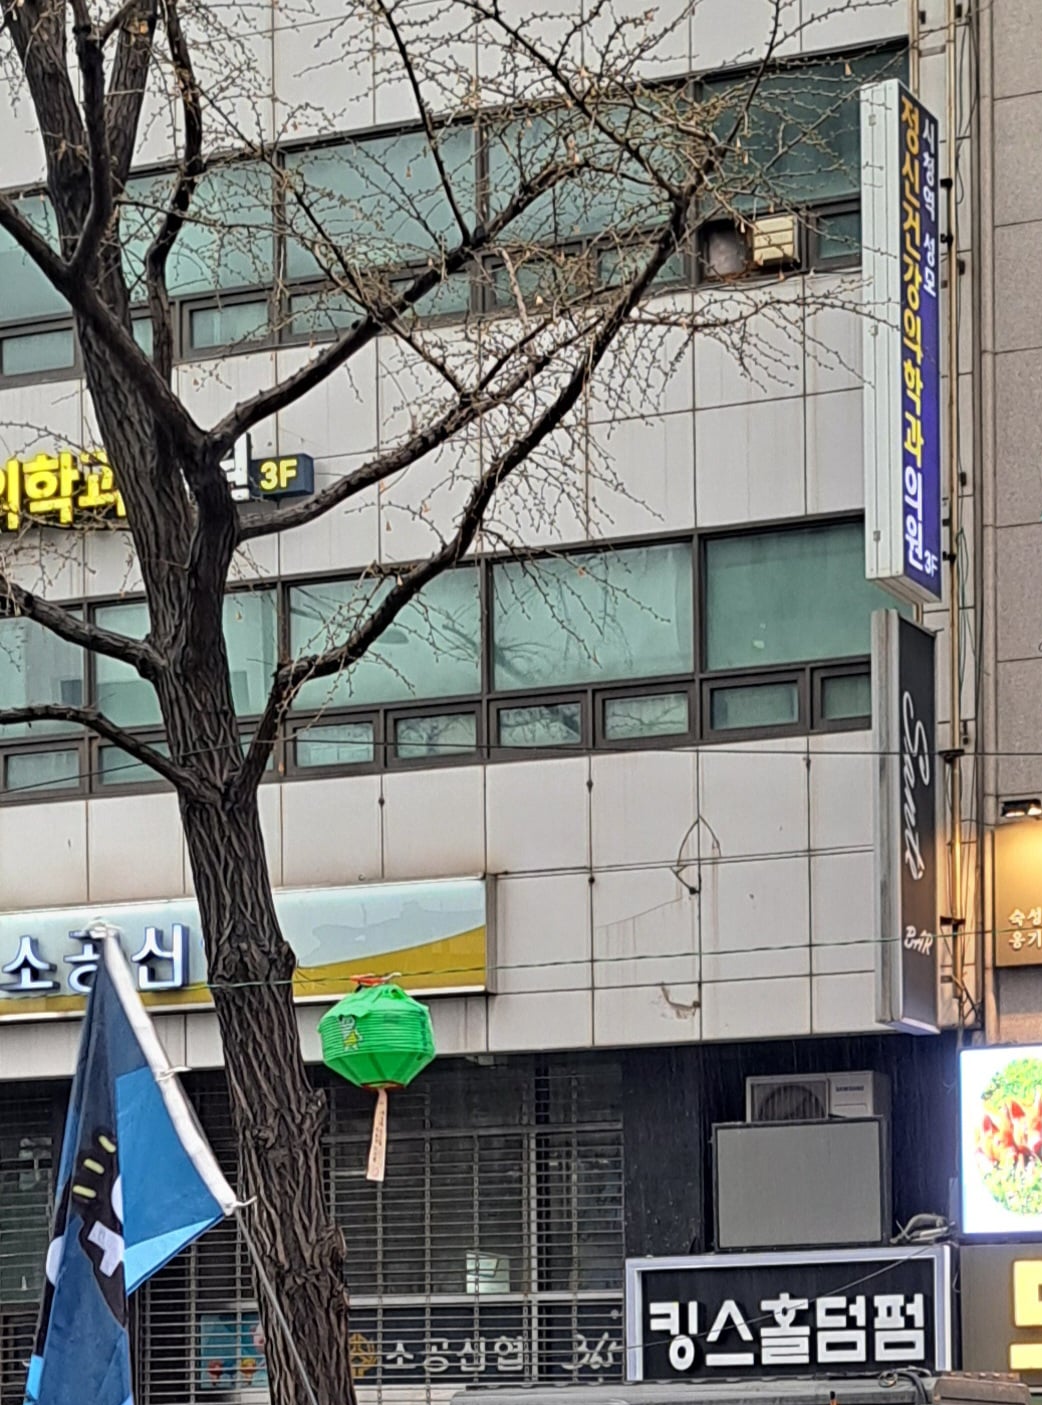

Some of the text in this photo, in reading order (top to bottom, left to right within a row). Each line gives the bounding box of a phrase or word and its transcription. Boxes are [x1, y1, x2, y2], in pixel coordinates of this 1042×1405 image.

[922, 118, 936, 222] 시청역
[259, 458, 298, 491] 3F
[924, 549, 938, 577] 3F
[649, 1292, 925, 1371] 킹스홀덤펌
[383, 1335, 524, 1373] 소공신협
